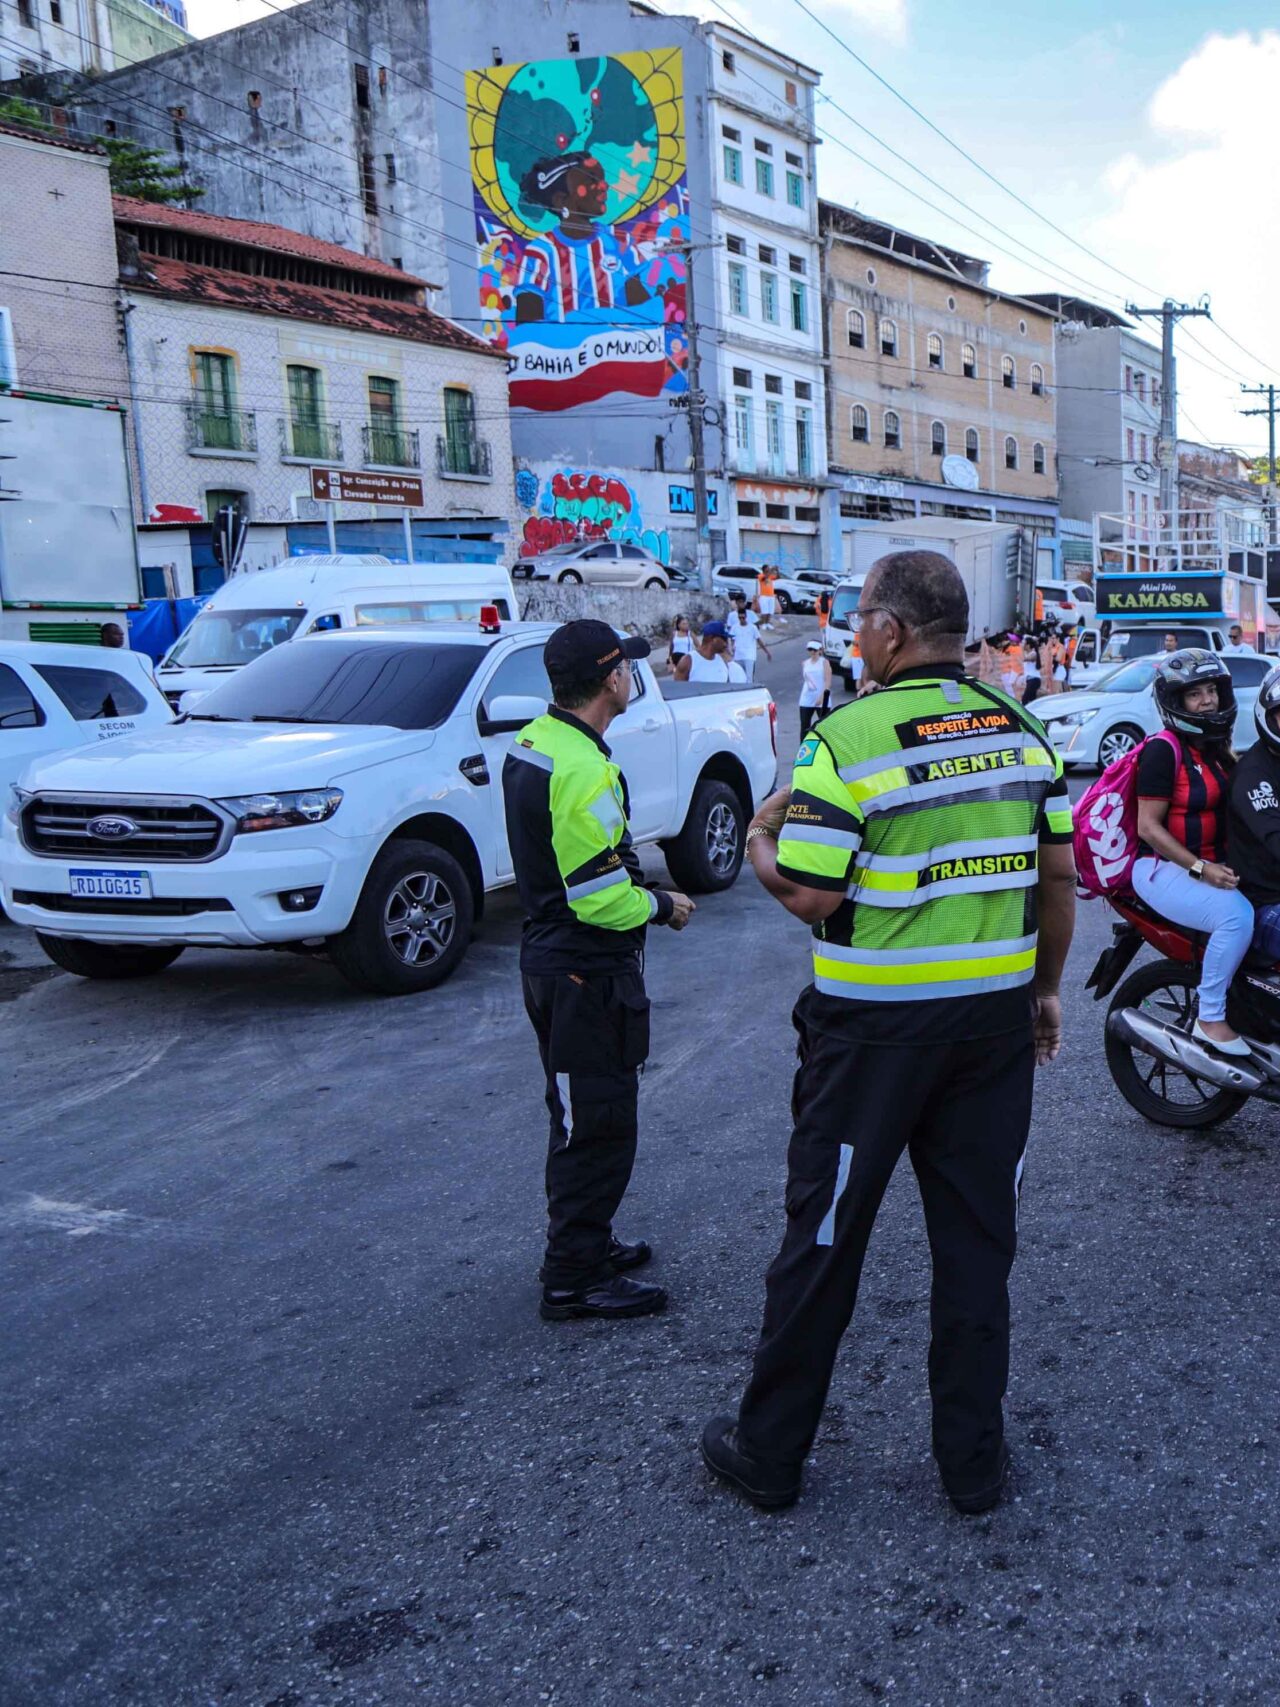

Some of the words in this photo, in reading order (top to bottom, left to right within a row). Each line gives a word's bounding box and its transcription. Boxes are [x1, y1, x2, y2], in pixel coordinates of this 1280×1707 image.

[578, 345, 588, 366] É
[594, 344, 603, 358] O
[606, 336, 662, 357] MUNDO!
[355, 477, 389, 488] Conceição
[391, 481, 400, 489] da
[401, 481, 420, 490] Praia
[343, 489, 375, 499] Elevador
[377, 493, 405, 502] Lacerda
[670, 486, 716, 513] INX
[1139, 583, 1160, 592] Mini
[1161, 583, 1177, 591] Trio
[1108, 592, 1209, 608] KAMASSA
[99, 722, 136, 731] SECOM
[917, 719, 970, 736] RESPEITE
[972, 717, 981, 729] A
[981, 714, 1010, 728] VIDA
[928, 749, 1017, 780] AGENTE
[95, 820, 121, 835] Ford
[930, 853, 1027, 882] TRÂNSITO
